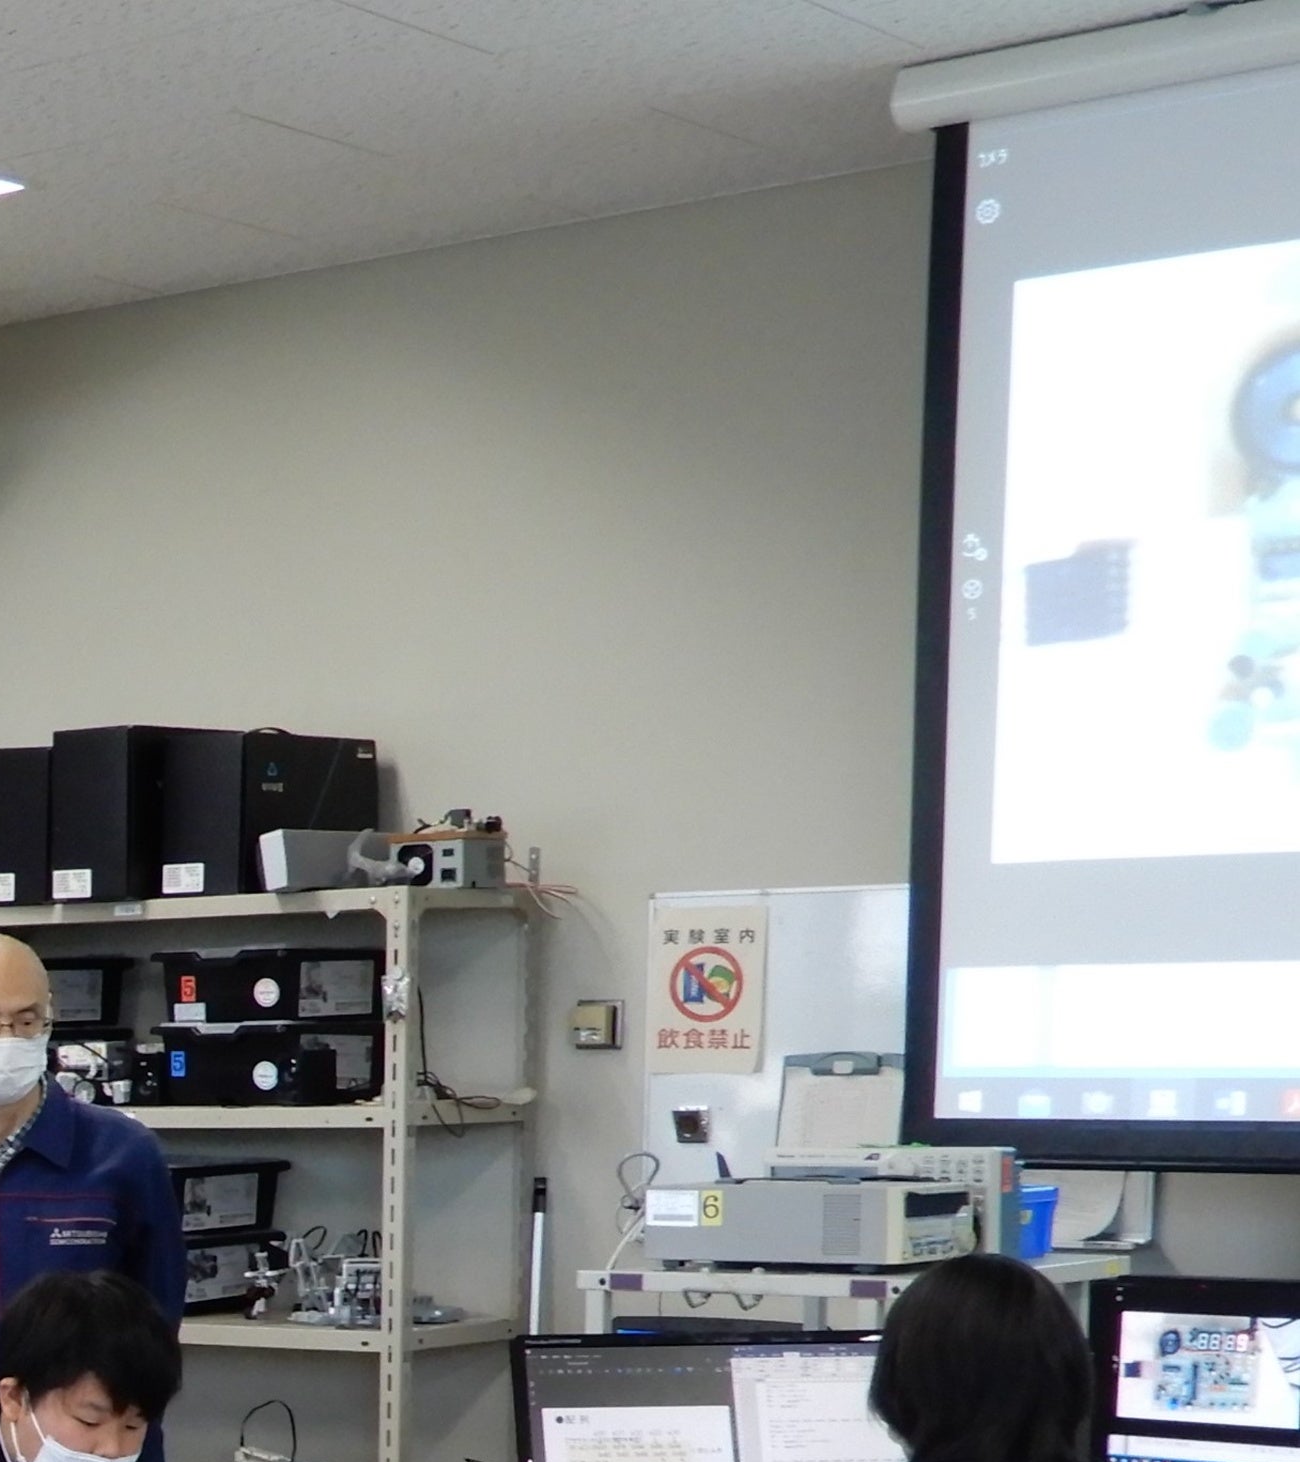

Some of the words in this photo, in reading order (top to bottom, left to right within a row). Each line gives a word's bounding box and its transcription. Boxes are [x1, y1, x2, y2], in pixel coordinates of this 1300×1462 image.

[663, 927, 755, 945] 実験室内
[657, 1028, 751, 1050] 飲食禁止
[703, 1195, 719, 1219] 6
